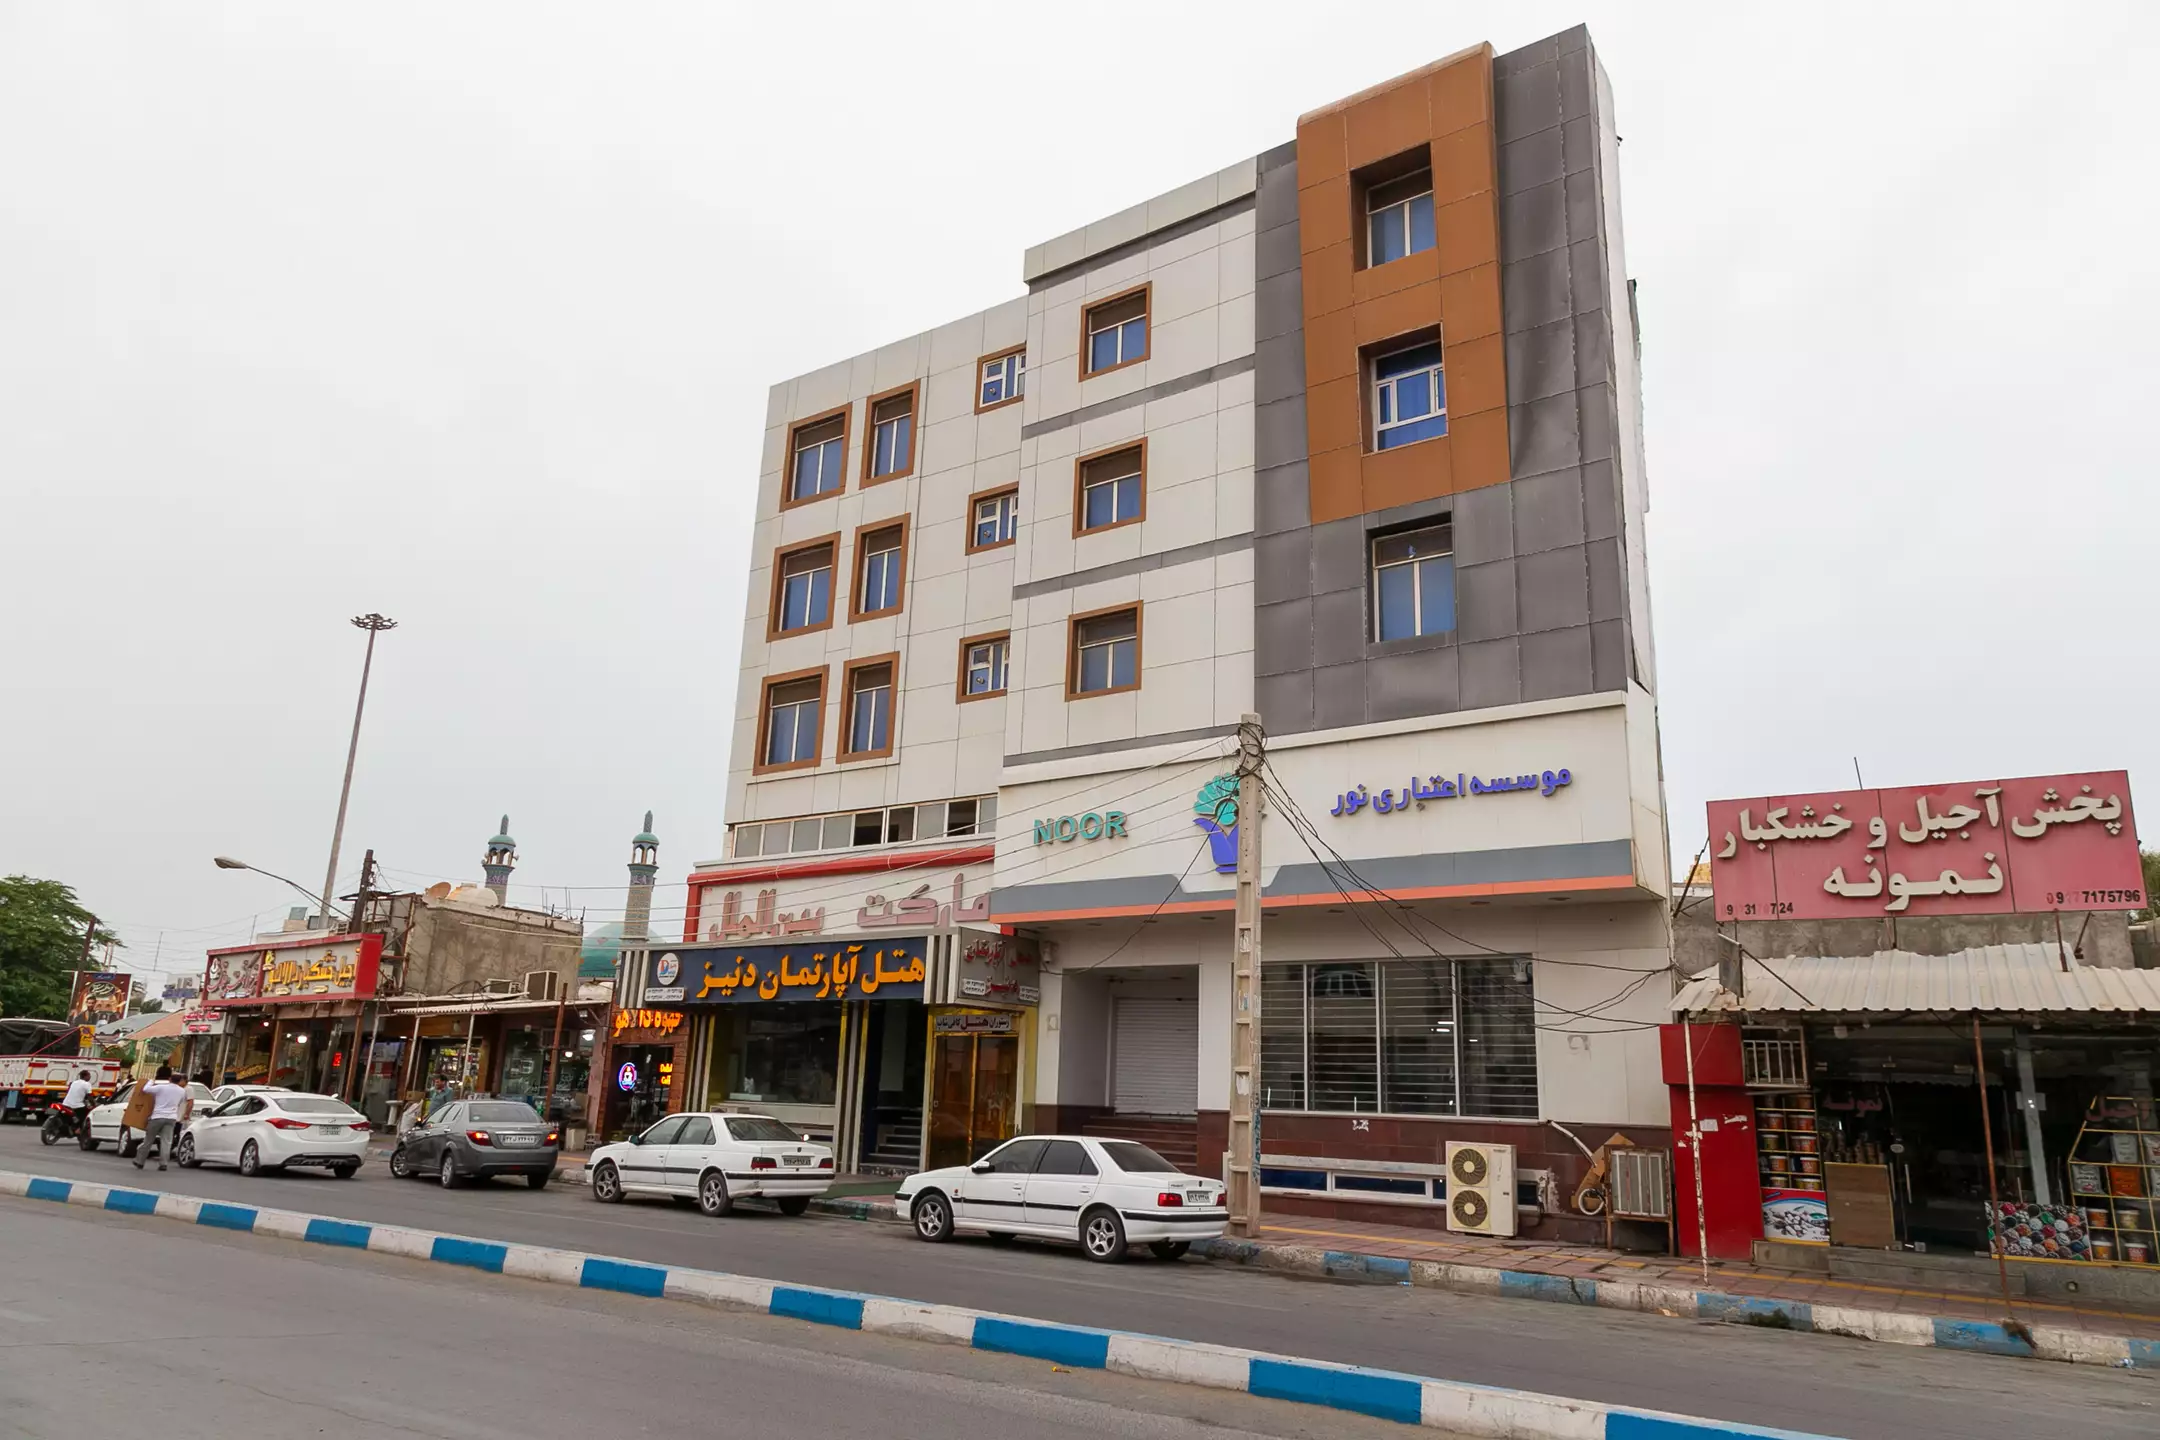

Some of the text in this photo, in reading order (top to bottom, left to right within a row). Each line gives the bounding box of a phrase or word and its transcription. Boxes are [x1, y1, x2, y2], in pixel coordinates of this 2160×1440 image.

[1330, 768, 1572, 816] موسسه اعتباری نور
[1033, 810, 1129, 845] NOOR
[1717, 784, 2123, 858] پخش آجیل و خشکبار
[857, 872, 991, 929] مارکت
[1823, 852, 2004, 911] نمونه
[696, 945, 925, 1000] هتل آپارتمان دنیز
[960, 1015, 988, 1030] هتل
